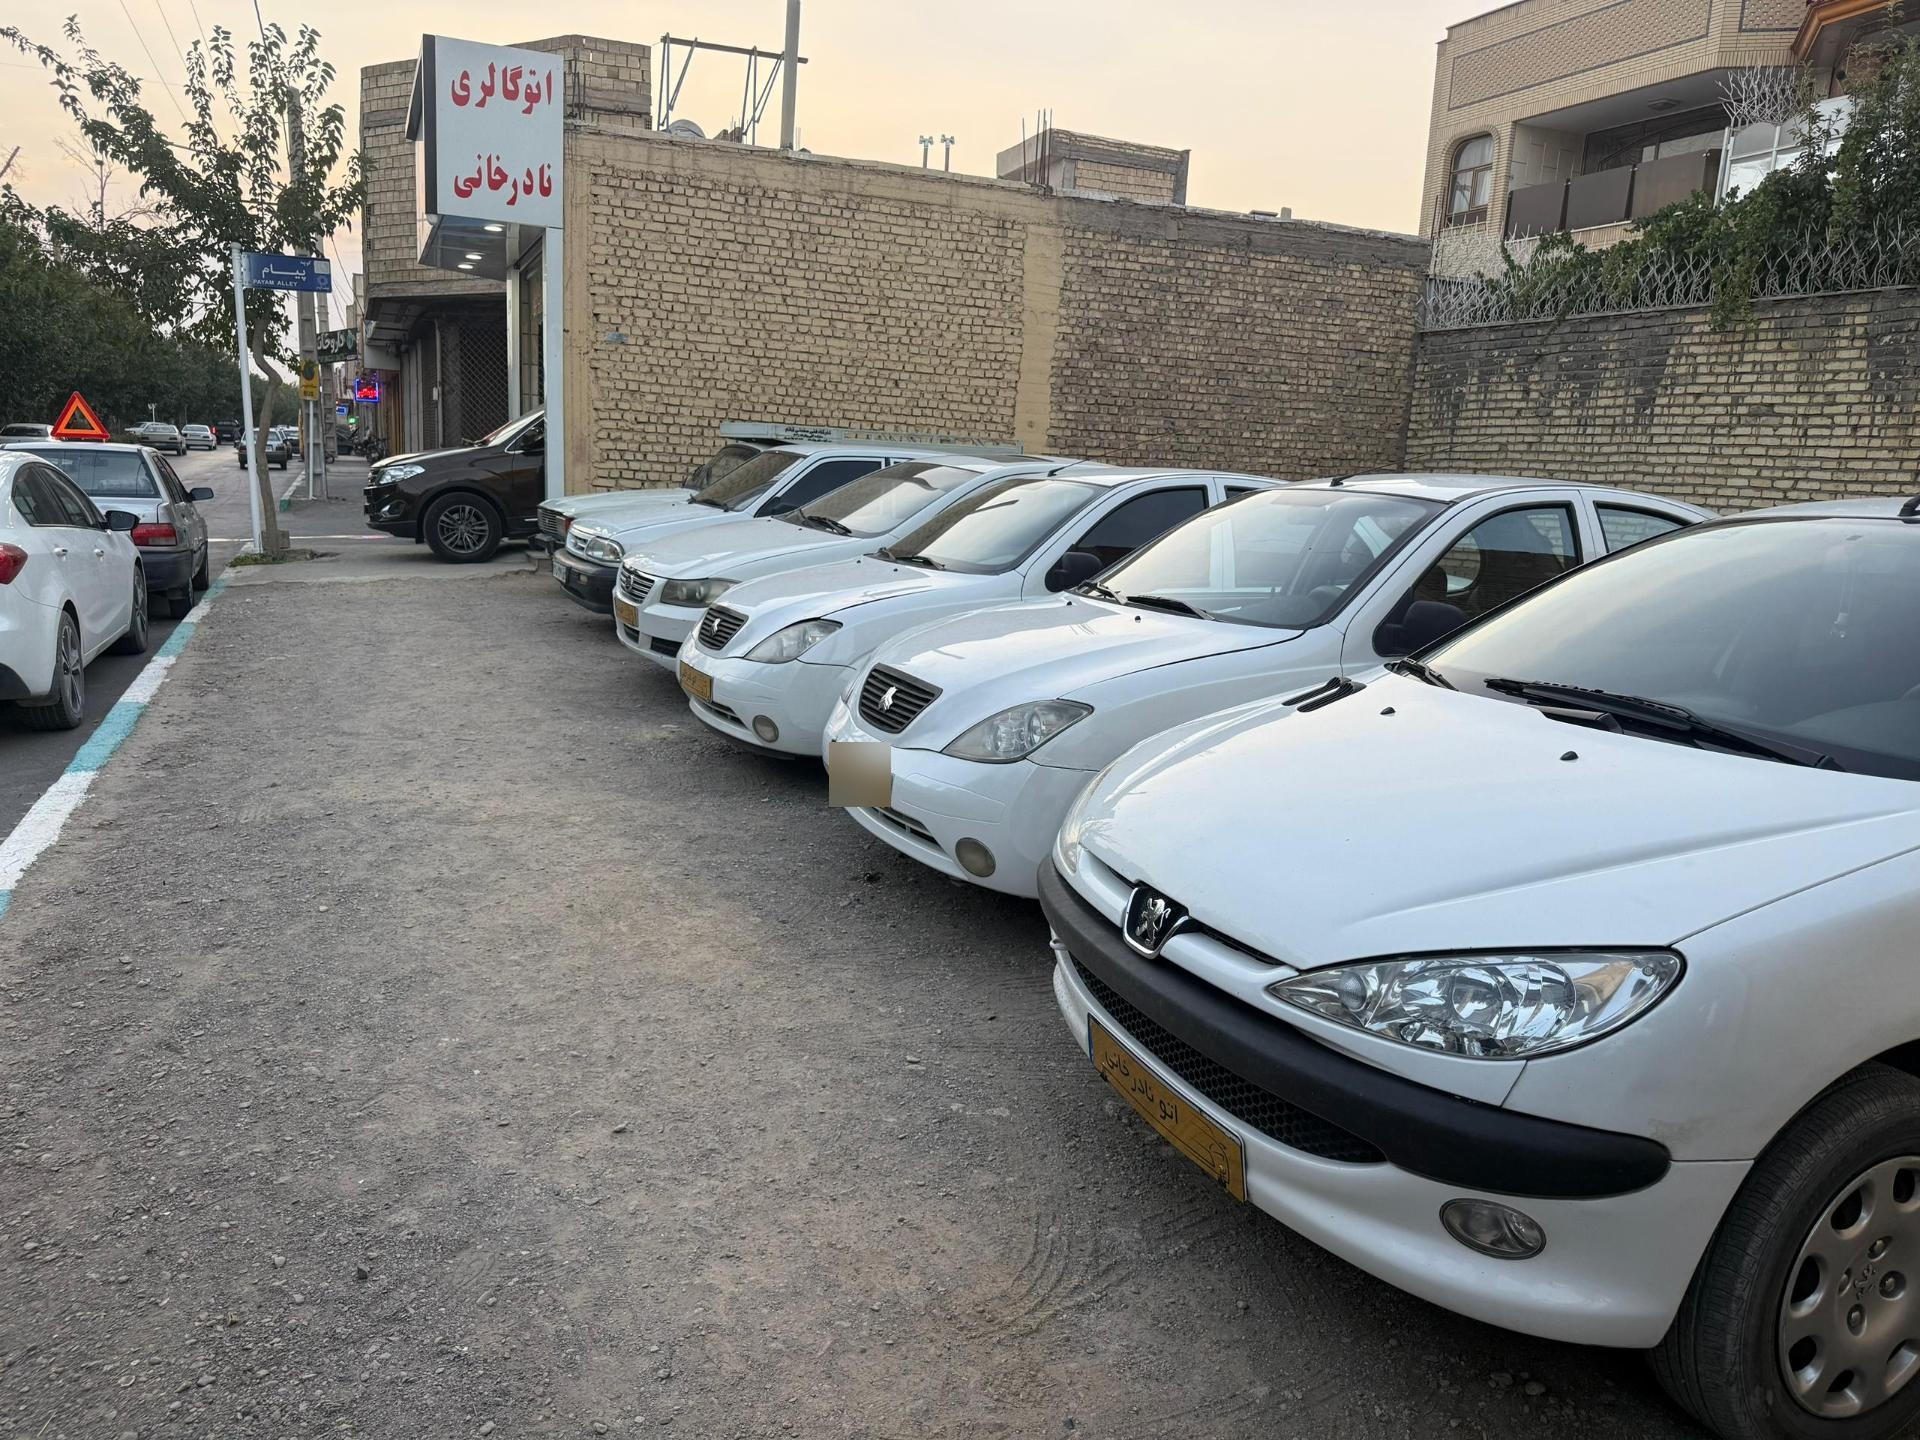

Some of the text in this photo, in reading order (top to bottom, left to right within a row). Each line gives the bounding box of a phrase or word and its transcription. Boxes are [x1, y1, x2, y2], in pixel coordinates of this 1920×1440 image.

[262, 263, 306, 281] پیام
[317, 331, 346, 354] داروخان
[1159, 1100, 1178, 1124] اتو
